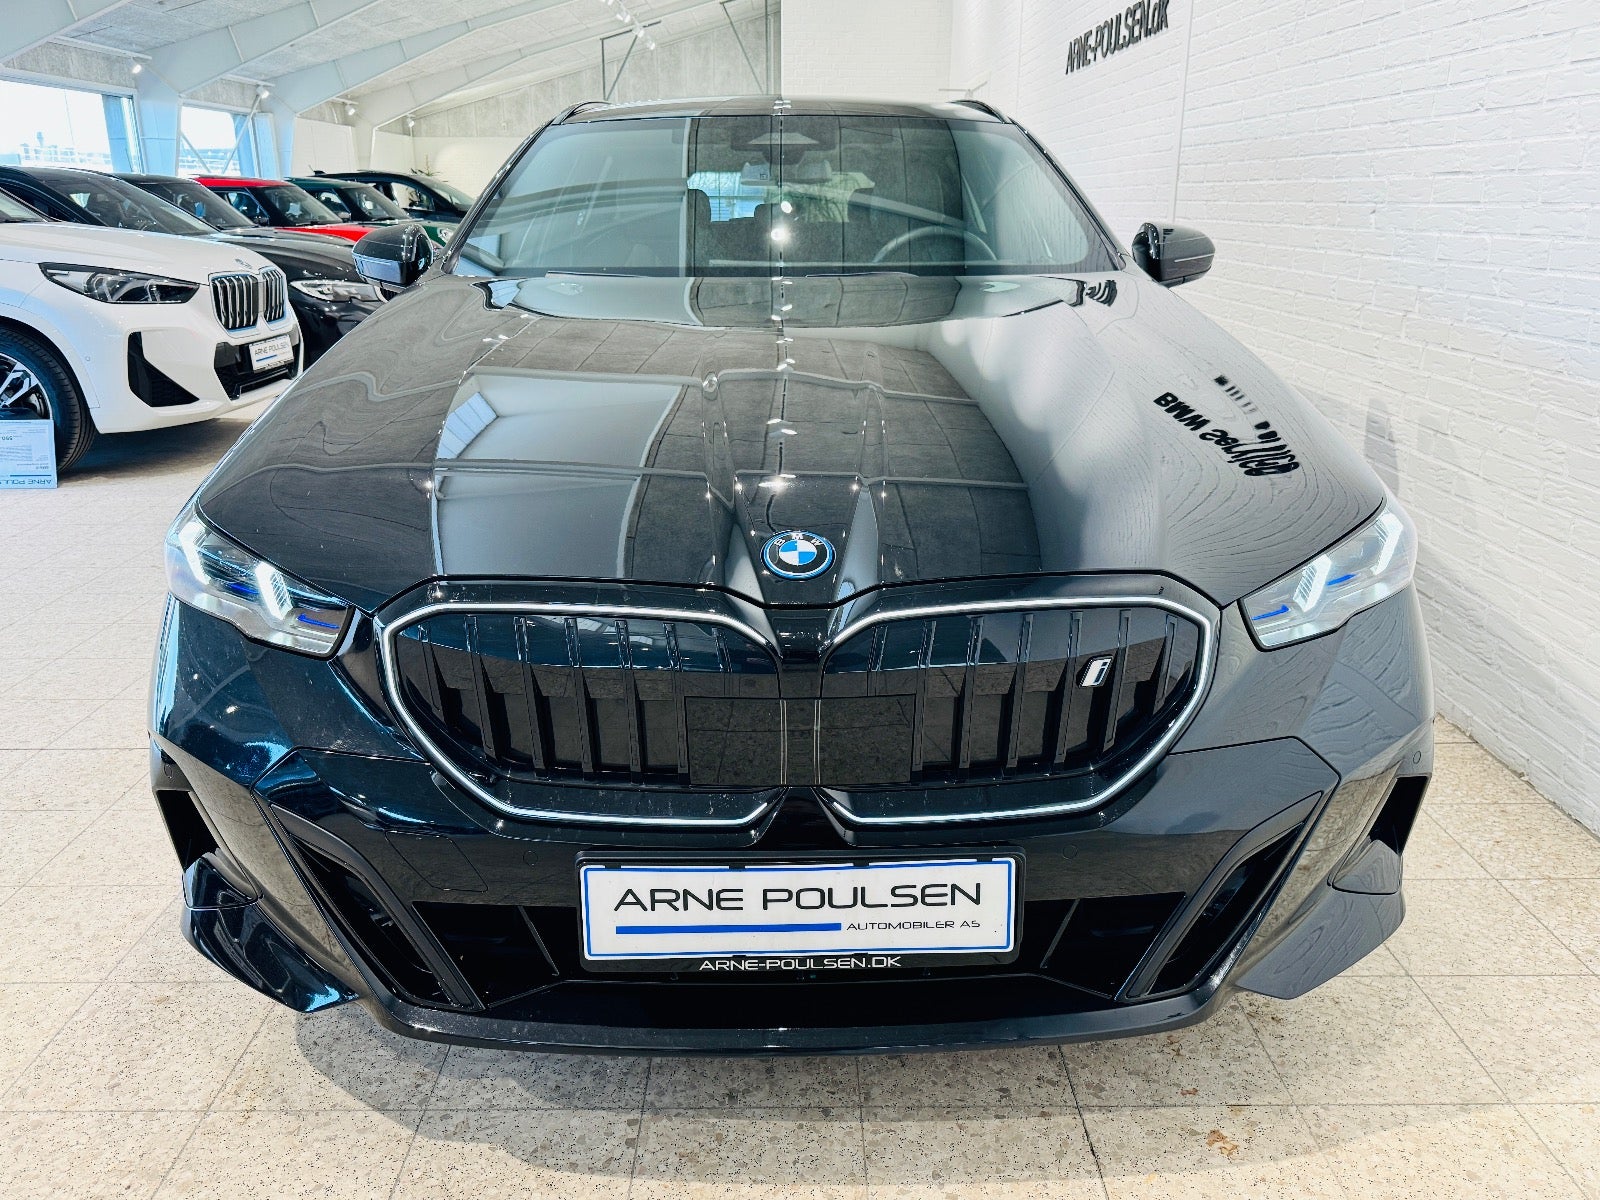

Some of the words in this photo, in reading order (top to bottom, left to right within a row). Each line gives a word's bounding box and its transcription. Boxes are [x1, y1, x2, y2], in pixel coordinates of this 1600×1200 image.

[614, 888, 744, 912] ARNE
[762, 883, 981, 911] POULSEN
[847, 920, 955, 931] AUTOMOBILER
[960, 920, 981, 928] AS
[699, 956, 902, 971] ARNE-POULSEN.DK
